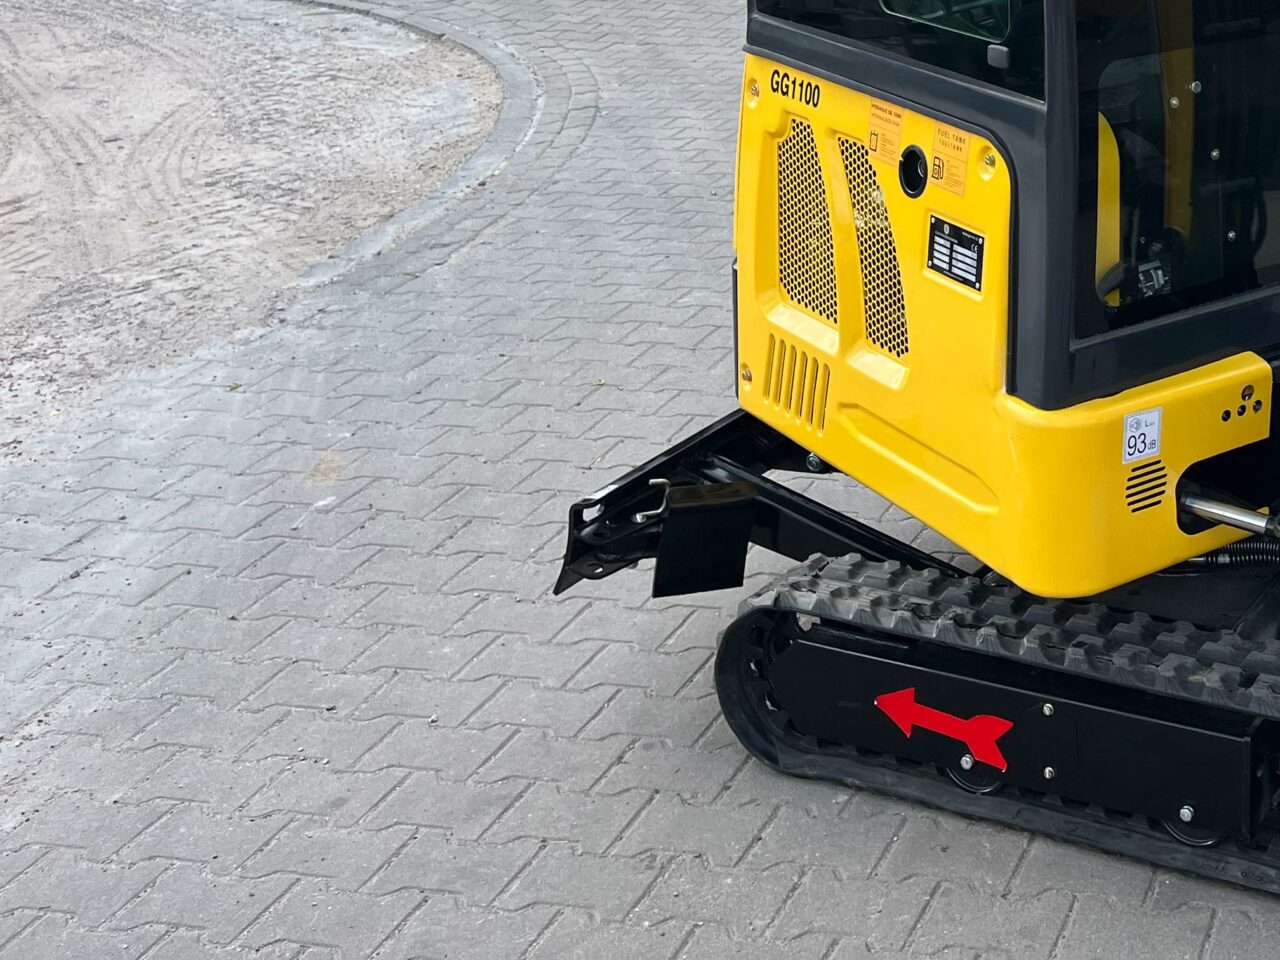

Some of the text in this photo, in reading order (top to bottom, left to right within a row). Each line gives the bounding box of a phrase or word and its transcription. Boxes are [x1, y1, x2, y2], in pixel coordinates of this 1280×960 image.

[771, 69, 820, 108] GG1100
[1127, 432, 1147, 457] 93
[1147, 439, 1157, 450] dB
